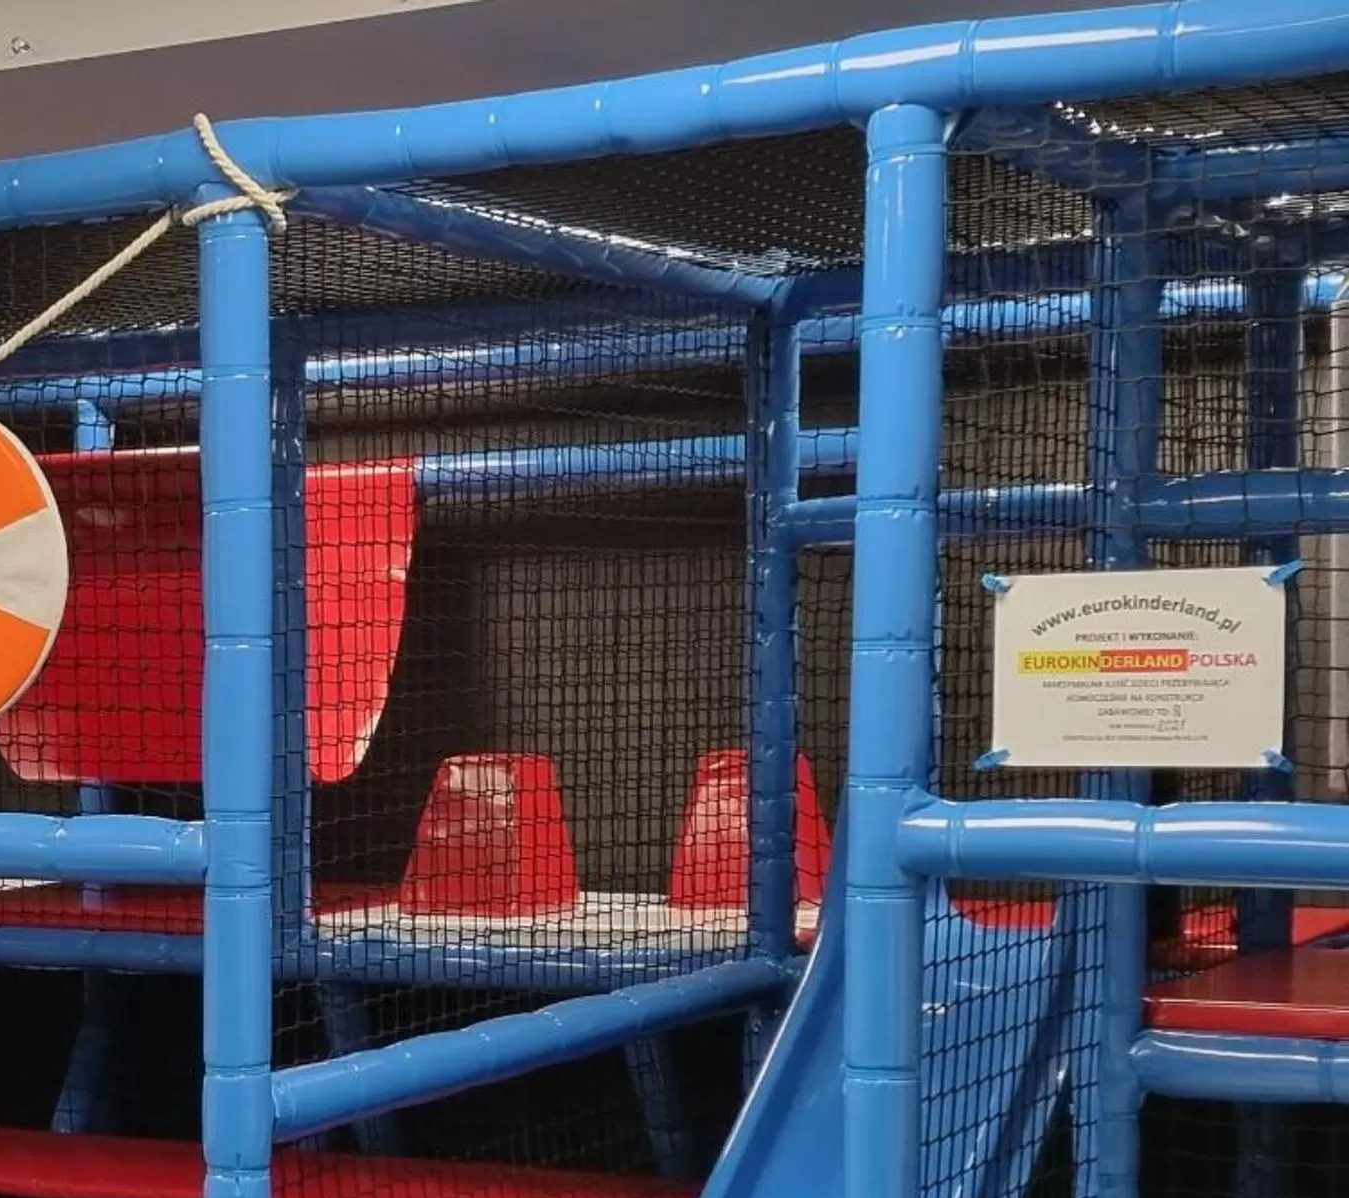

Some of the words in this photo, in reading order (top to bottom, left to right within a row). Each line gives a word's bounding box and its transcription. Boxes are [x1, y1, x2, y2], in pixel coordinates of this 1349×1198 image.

[1031, 595, 1242, 636] www.eurokinderland.pl
[1075, 633, 1119, 642] PROJEKT
[1190, 653, 1257, 667] POLSKA
